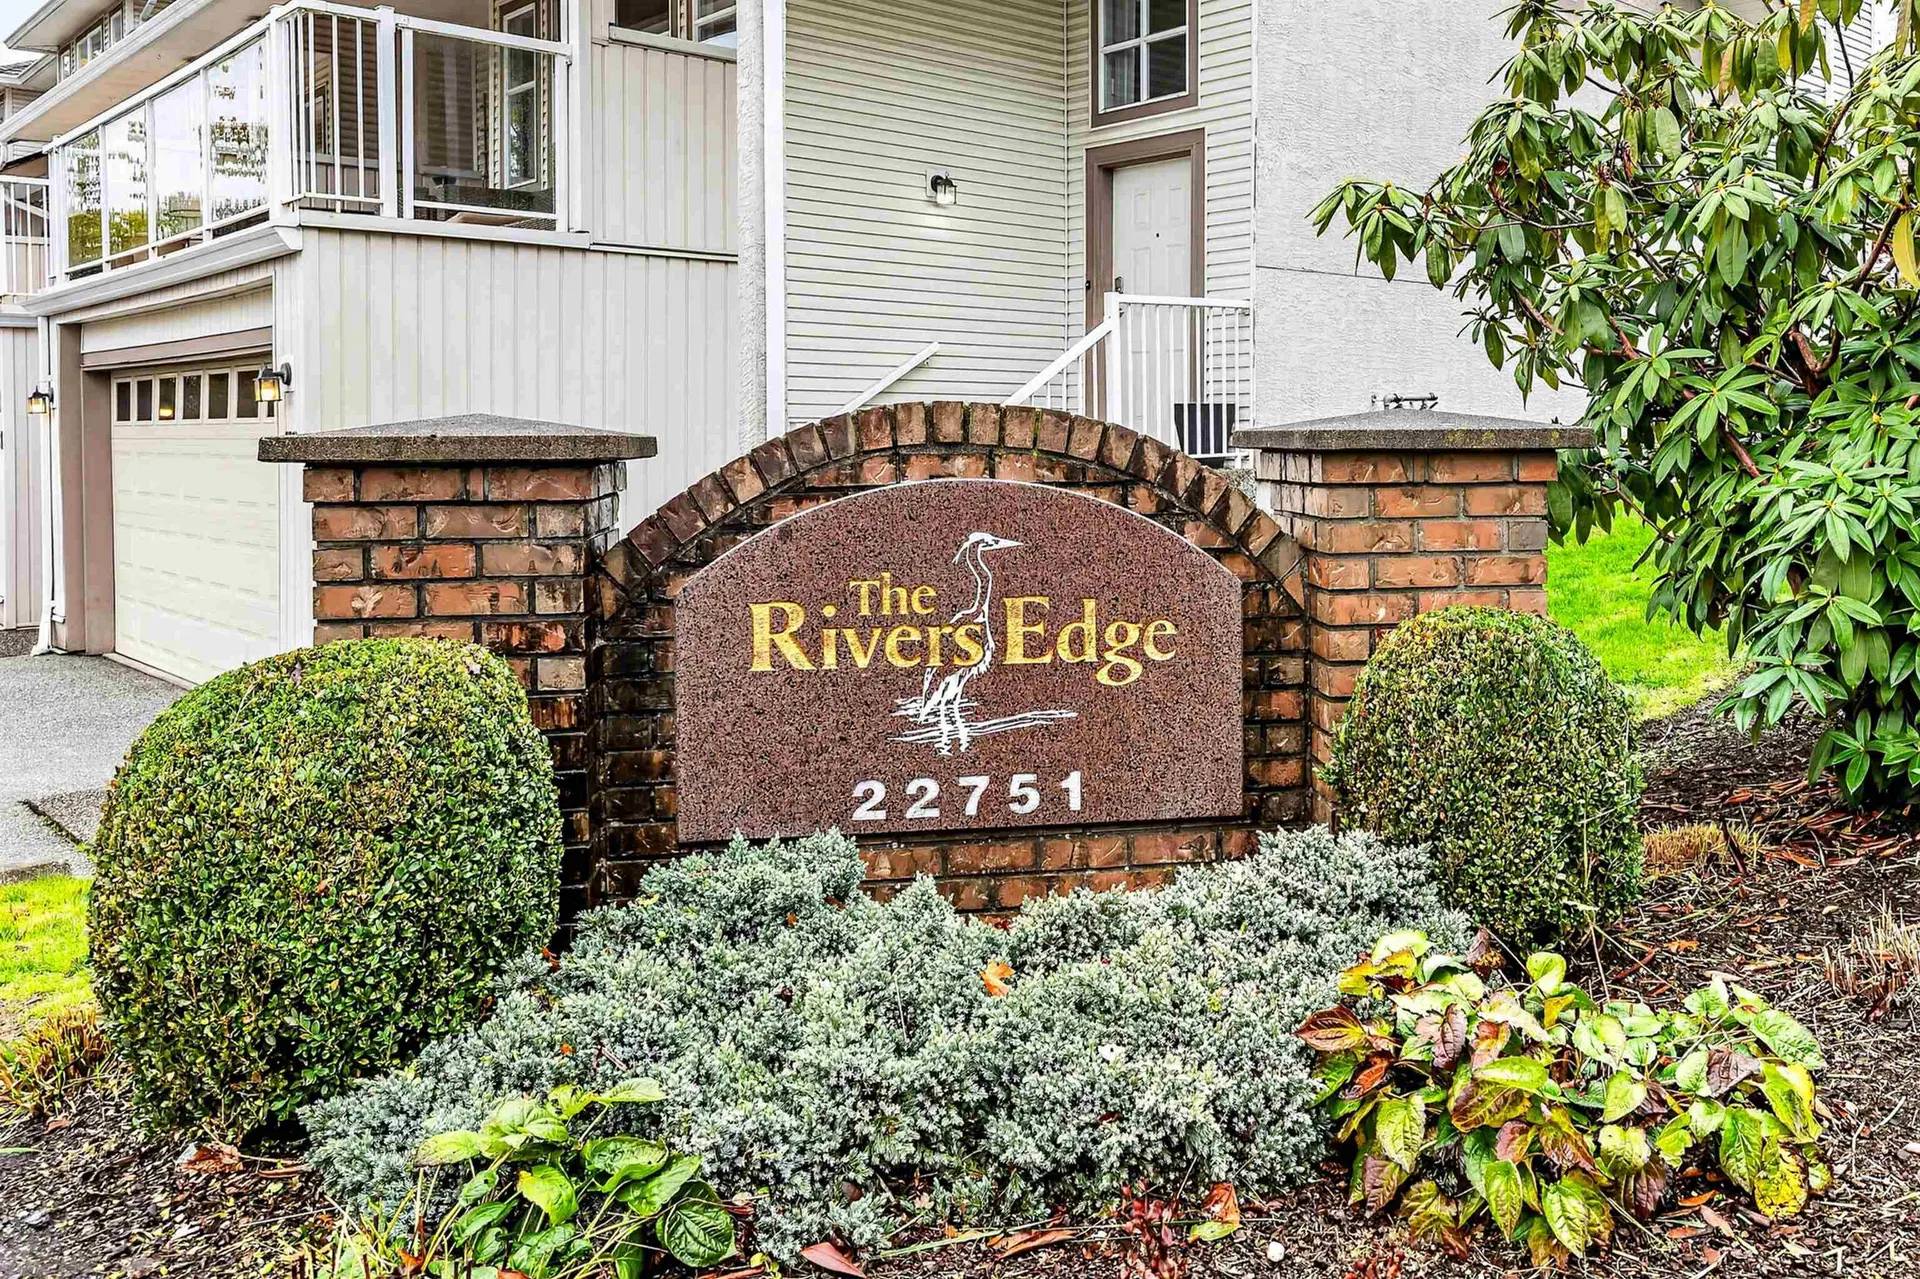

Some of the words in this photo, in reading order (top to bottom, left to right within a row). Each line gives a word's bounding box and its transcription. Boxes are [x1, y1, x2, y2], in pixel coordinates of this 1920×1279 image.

[849, 571, 937, 617] The
[748, 601, 985, 673] Rivers
[1001, 595, 1179, 687] Edge
[851, 770, 1082, 821] 22751
